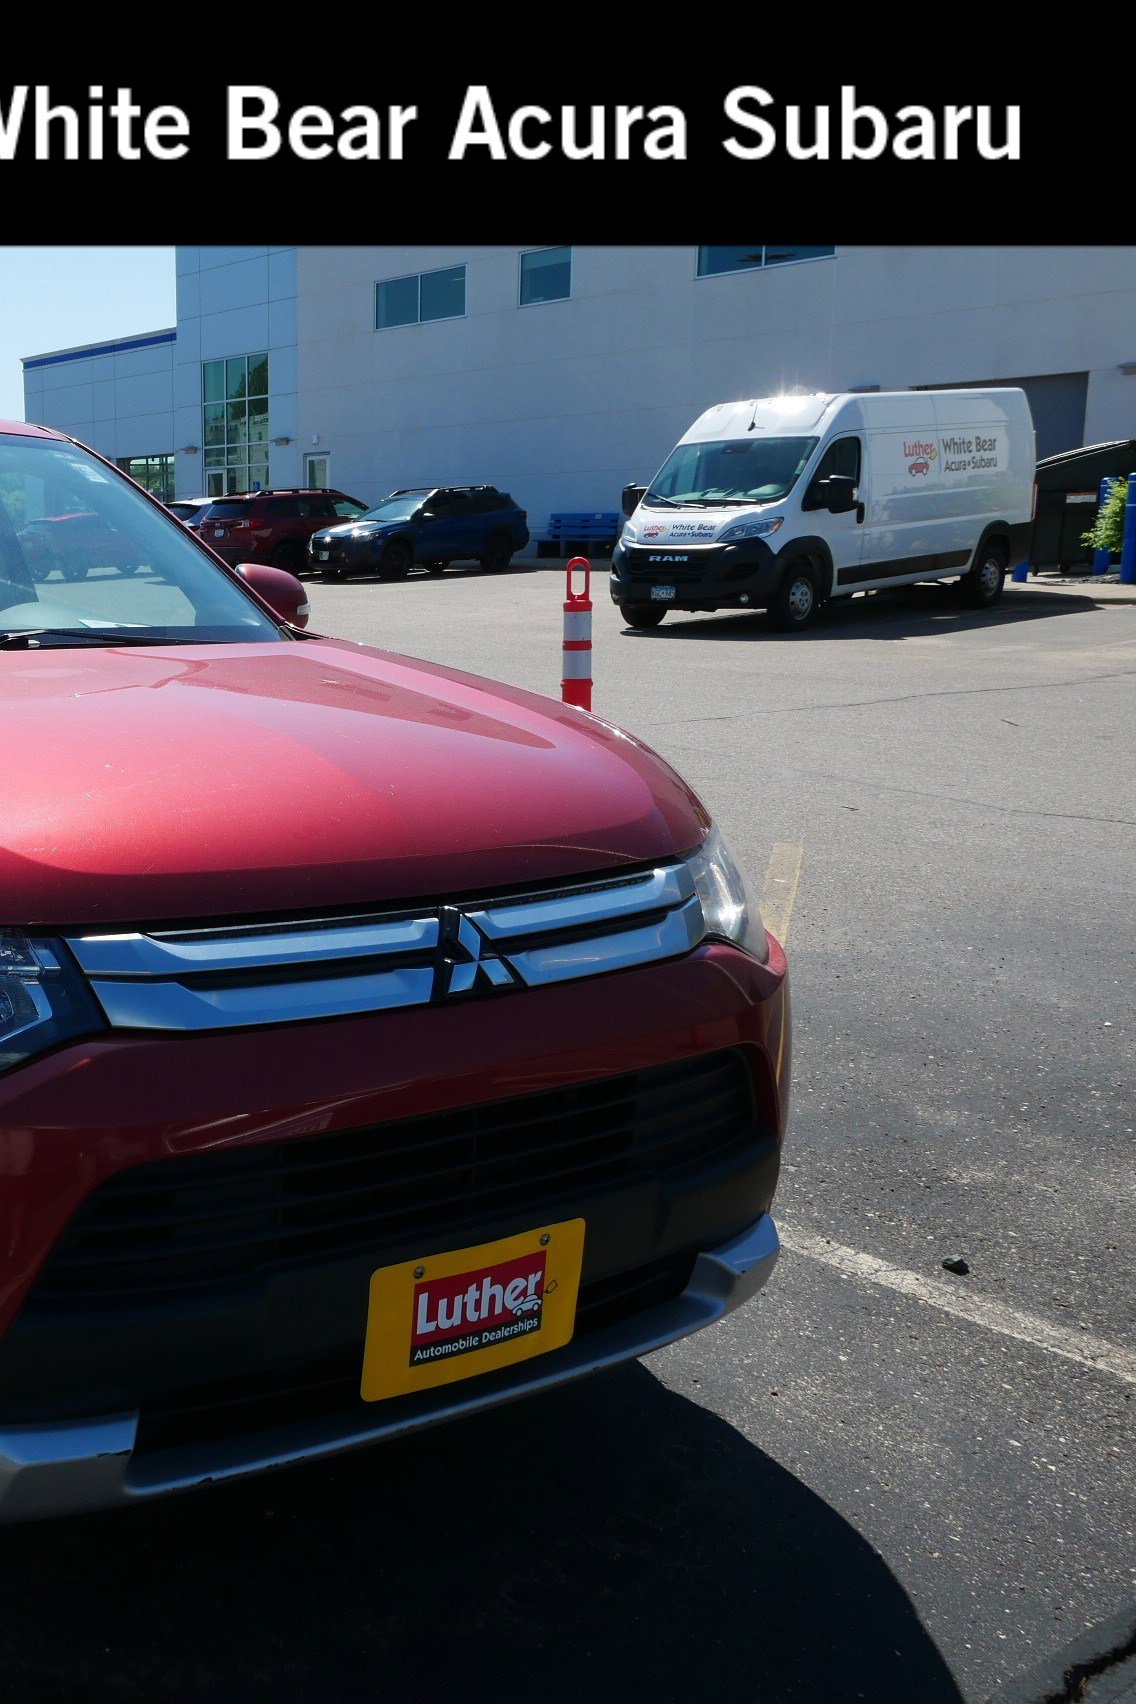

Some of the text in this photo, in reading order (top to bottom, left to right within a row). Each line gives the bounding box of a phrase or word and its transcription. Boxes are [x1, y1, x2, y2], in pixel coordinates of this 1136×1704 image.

[903, 440, 934, 457] Luther
[942, 435, 997, 455] White Bear
[672, 523, 716, 531] White Bear
[416, 1270, 543, 1335] Luther
[414, 1317, 538, 1361] Automobile Dealerships
